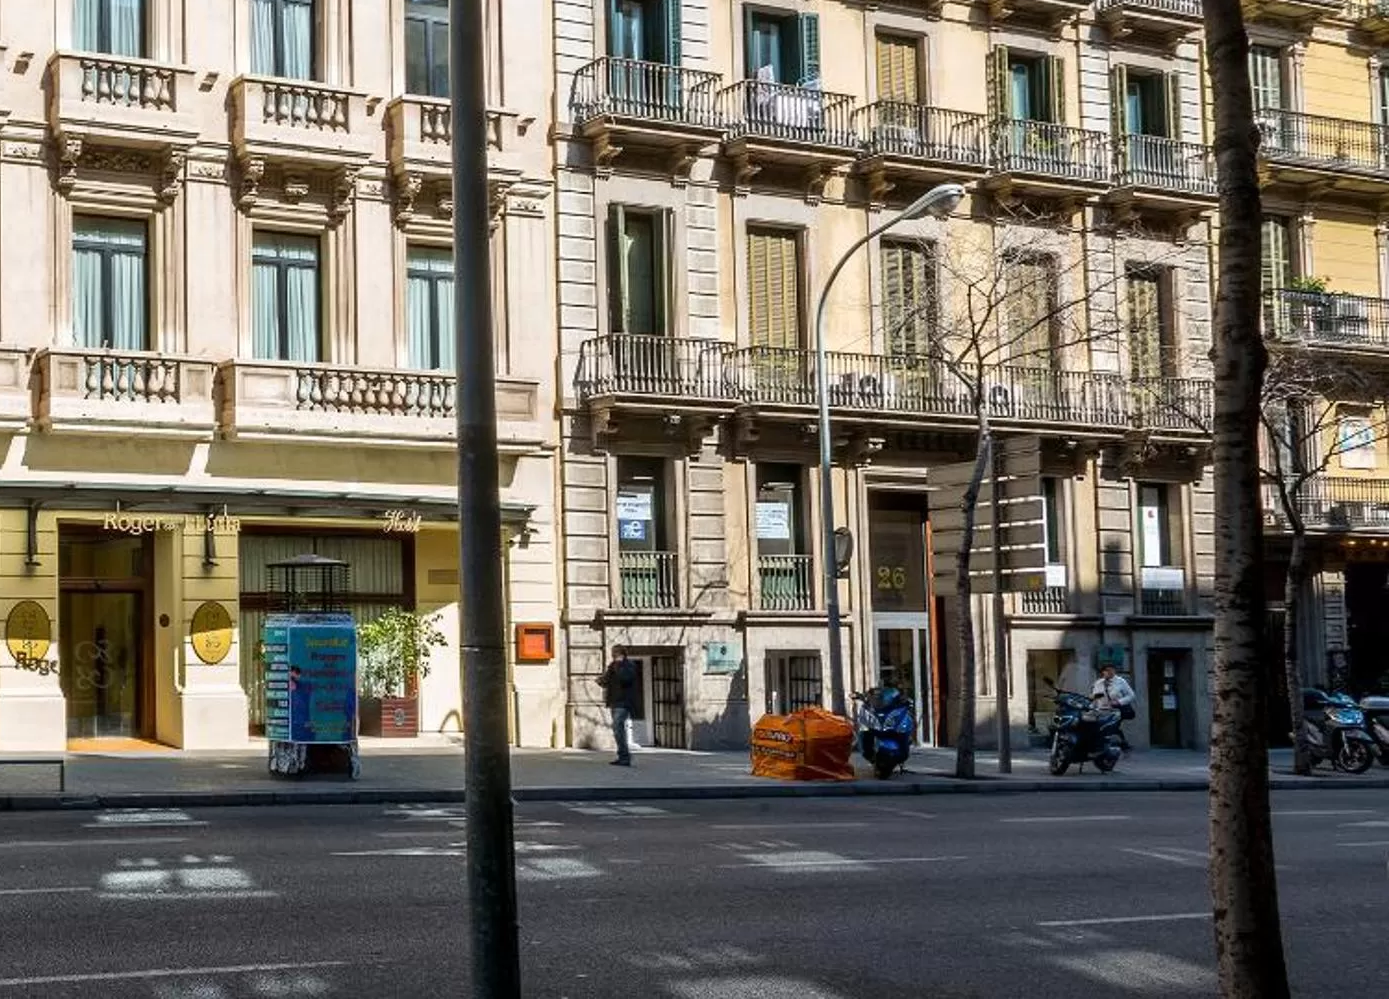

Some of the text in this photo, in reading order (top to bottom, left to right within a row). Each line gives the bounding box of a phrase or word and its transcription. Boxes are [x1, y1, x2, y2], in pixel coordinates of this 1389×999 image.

[103, 512, 161, 536] Roger
[383, 509, 422, 533] Hotel
[877, 566, 906, 589] 26
